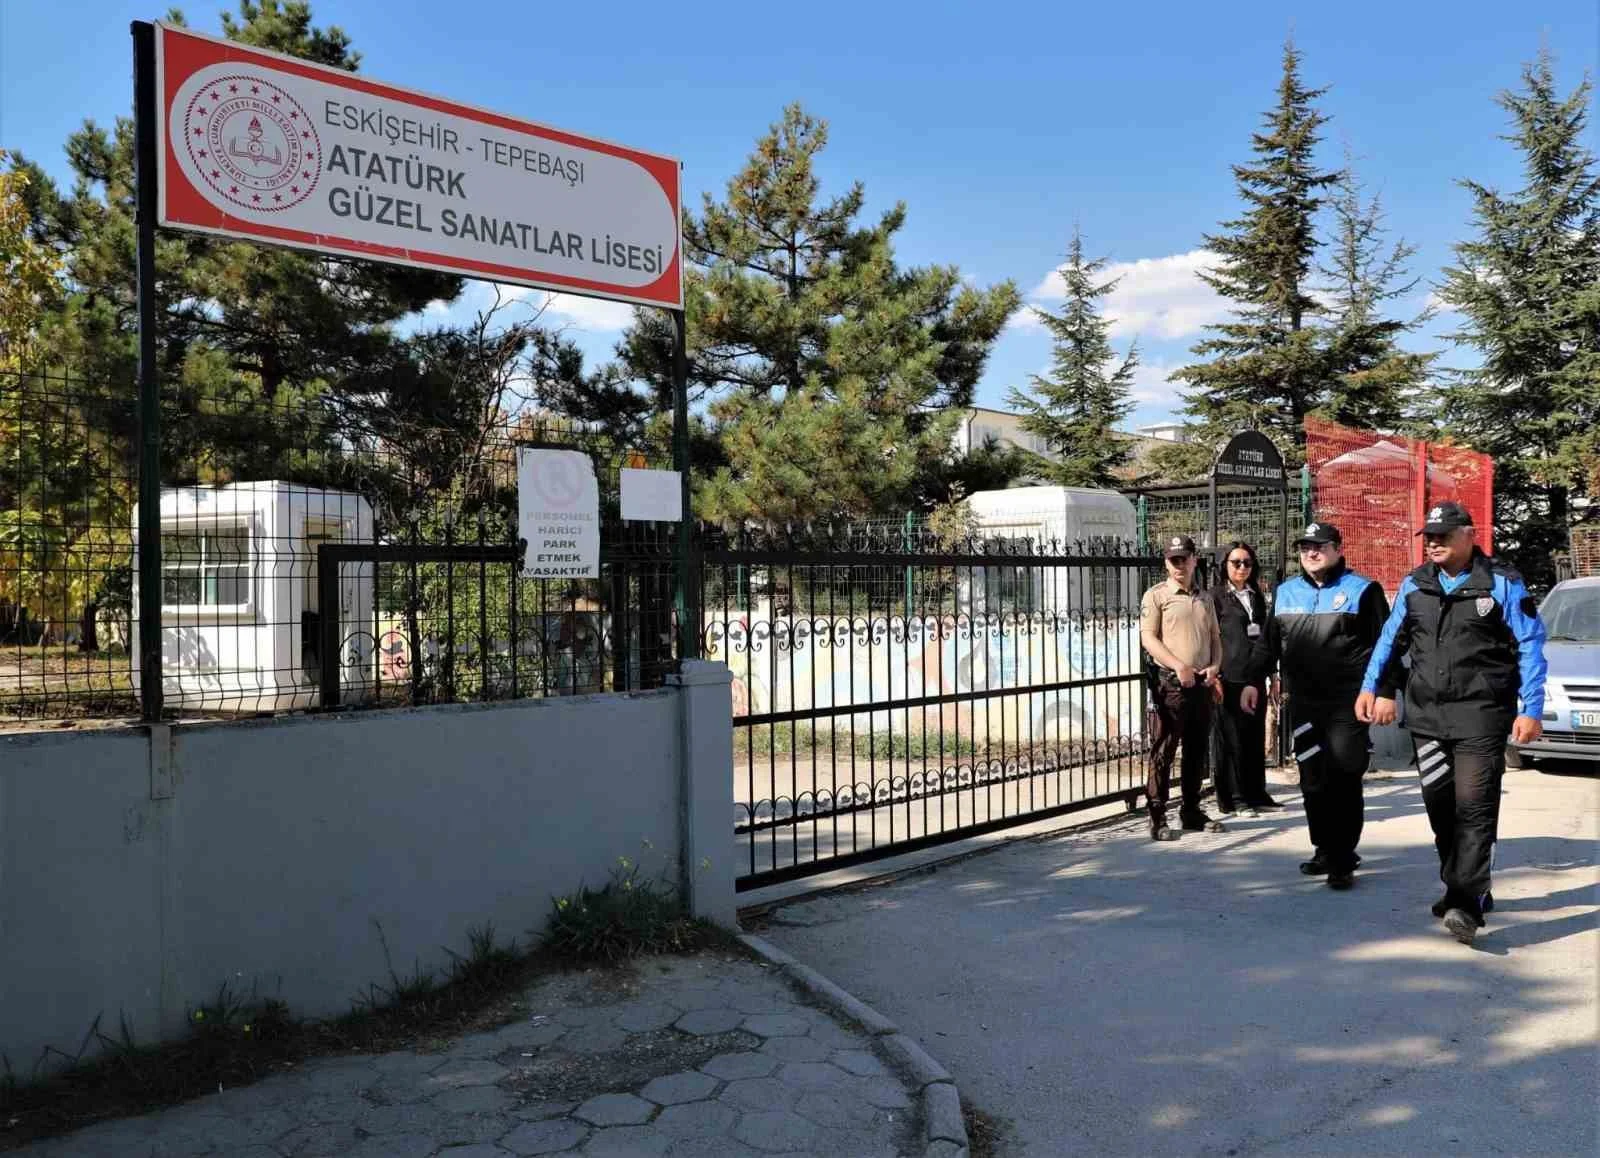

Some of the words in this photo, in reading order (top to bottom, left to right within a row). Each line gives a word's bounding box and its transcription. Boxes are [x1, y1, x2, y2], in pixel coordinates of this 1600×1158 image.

[325, 100, 459, 154] ESKİŞEHİR
[480, 138, 584, 187] TEPEBAŞI
[326, 144, 466, 199] ATATÜRK
[328, 185, 433, 232] GÜZEL
[440, 208, 584, 260] SANATLAR
[591, 234, 663, 274] LİSESİ
[537, 553, 582, 562] ETMEK
[543, 539, 577, 549] PARK
[525, 566, 591, 576] YASAKTIR
